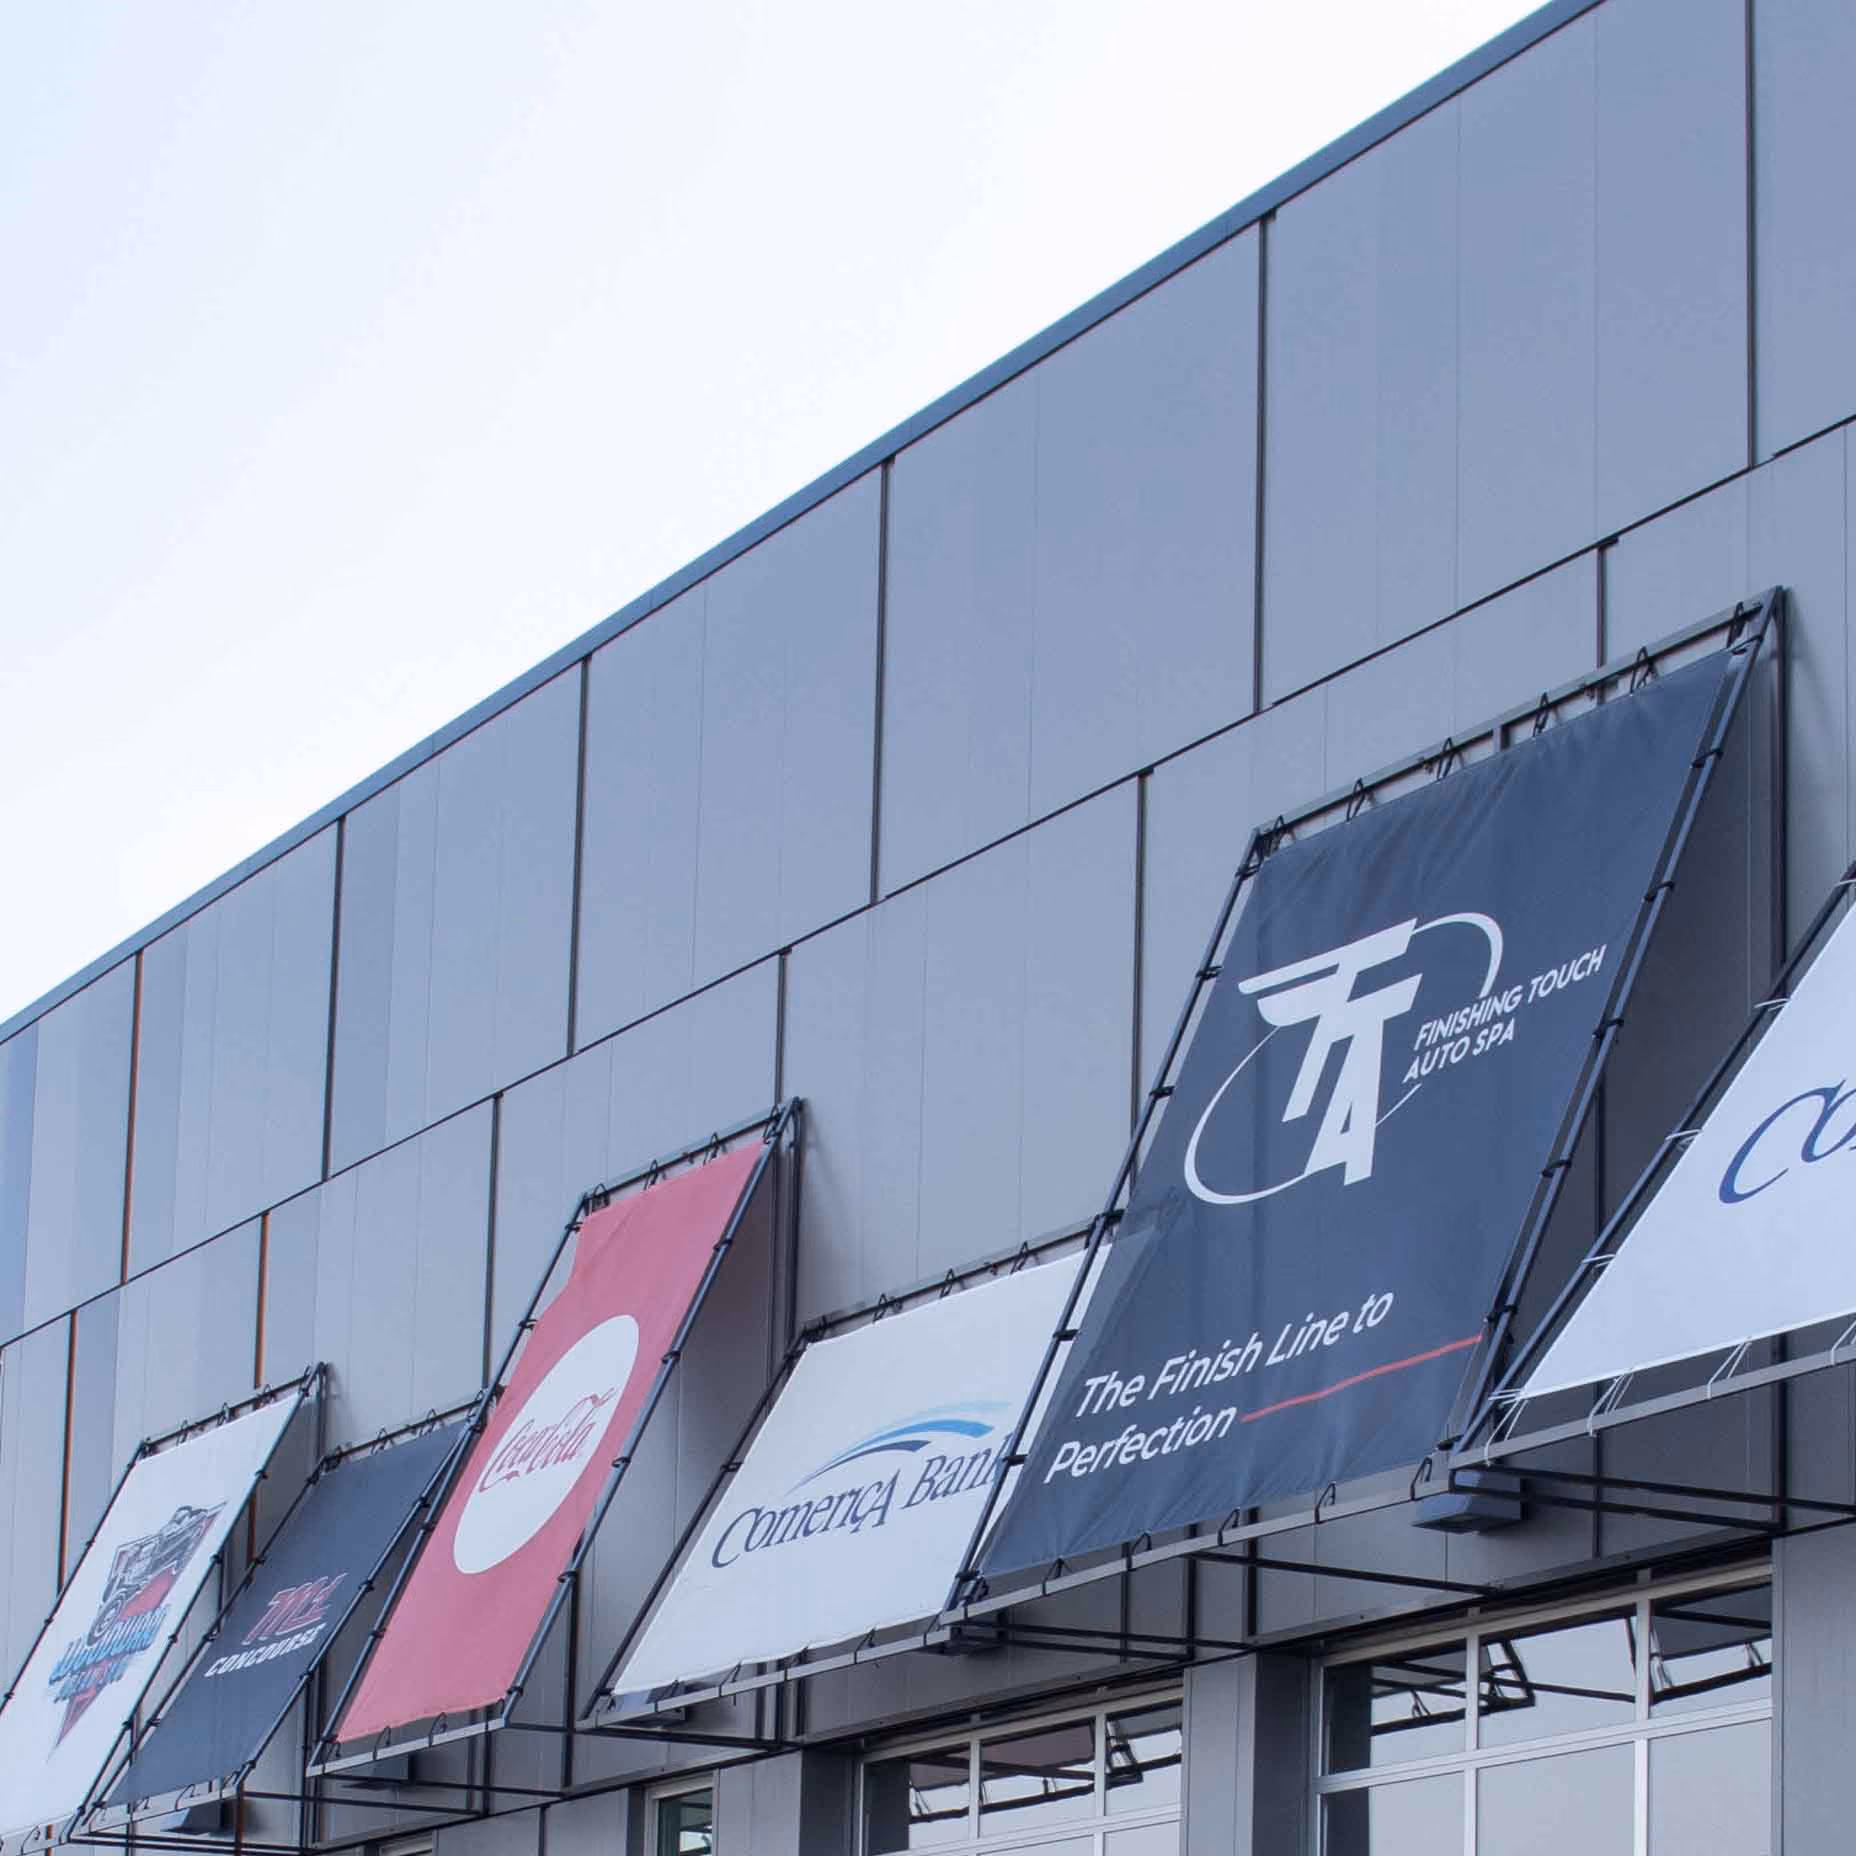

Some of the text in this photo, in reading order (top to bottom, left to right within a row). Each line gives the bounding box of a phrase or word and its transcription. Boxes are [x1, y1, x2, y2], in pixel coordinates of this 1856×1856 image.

[1413, 943, 1608, 1050] FINISHING TOUCH
[1402, 1018, 1515, 1083] AUTO SPA
[1075, 1291, 1394, 1417] The Finish Line to
[1043, 1405, 1238, 1484] Perfection
[203, 1622, 328, 1678] CONCOURSE
